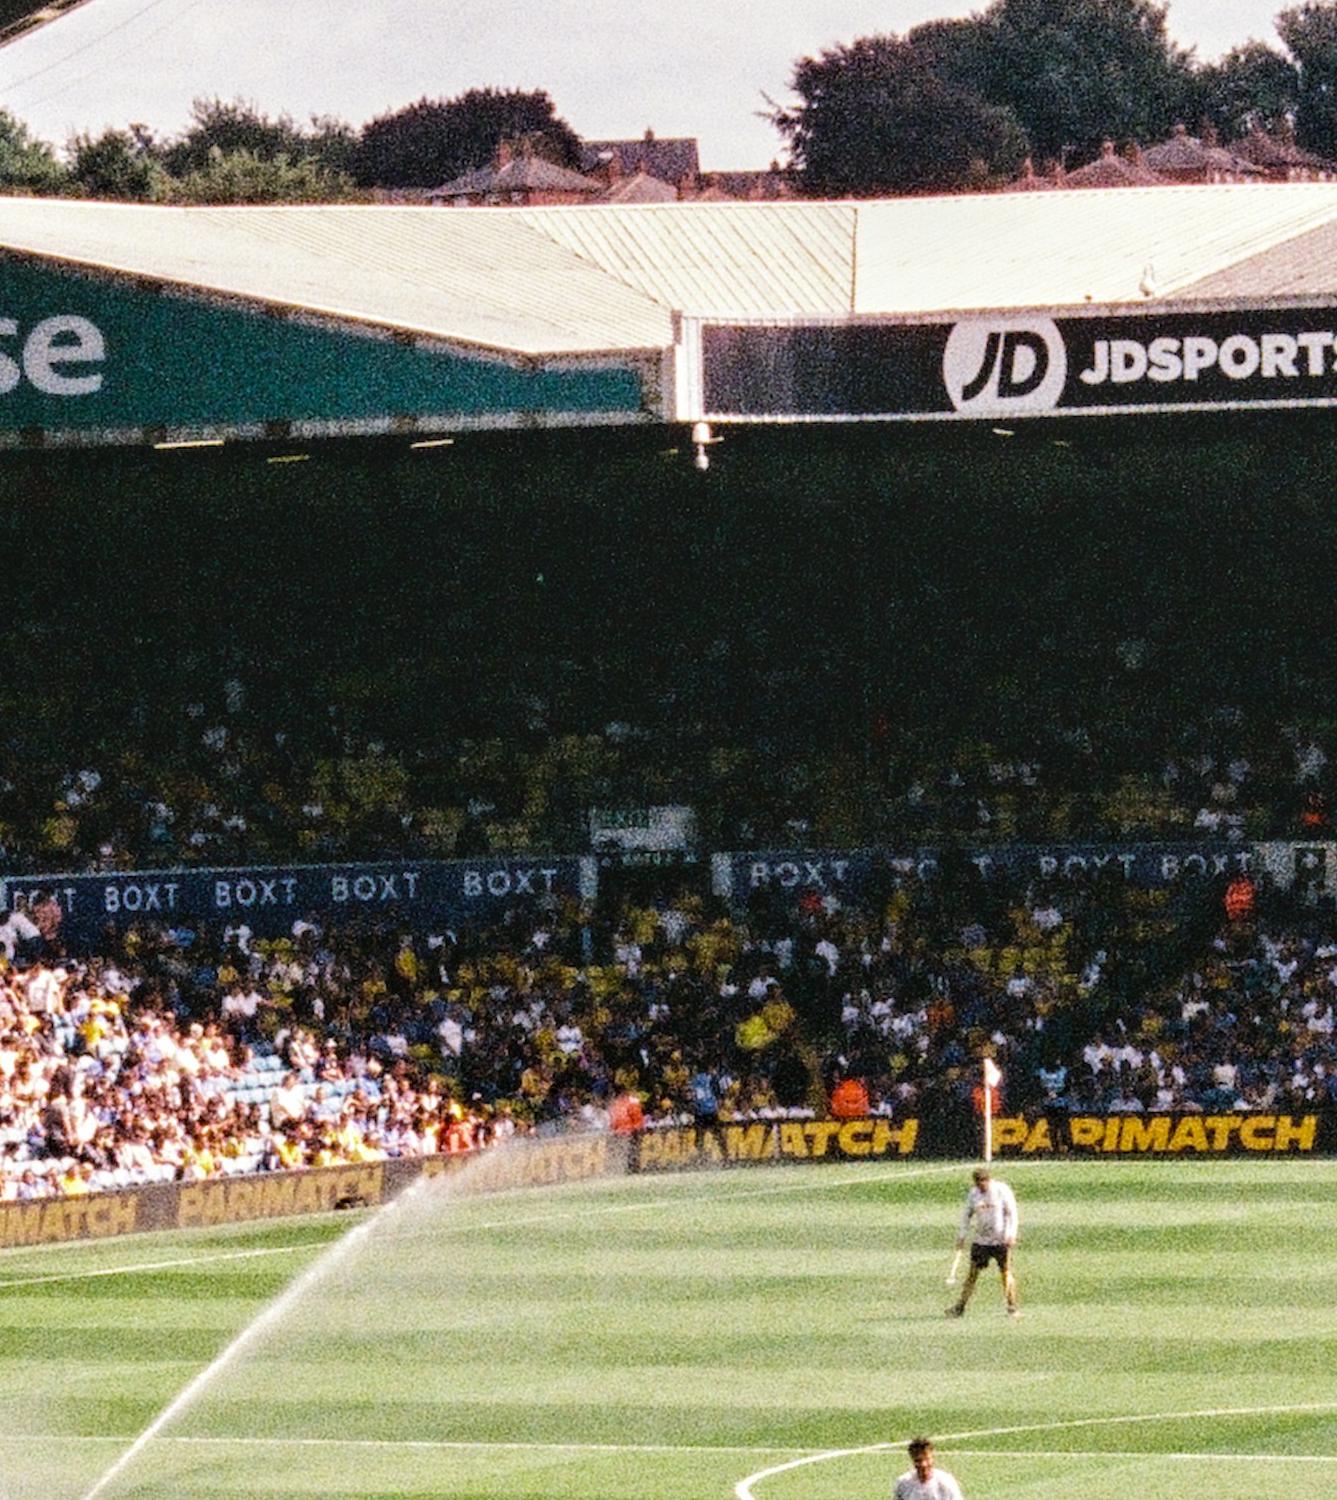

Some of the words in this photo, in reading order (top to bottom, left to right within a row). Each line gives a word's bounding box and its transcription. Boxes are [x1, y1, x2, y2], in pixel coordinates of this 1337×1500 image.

[105, 883, 180, 913] BOXT
[214, 877, 299, 908] BOXT
[331, 871, 420, 902] BOXT
[462, 868, 558, 898] BOXT
